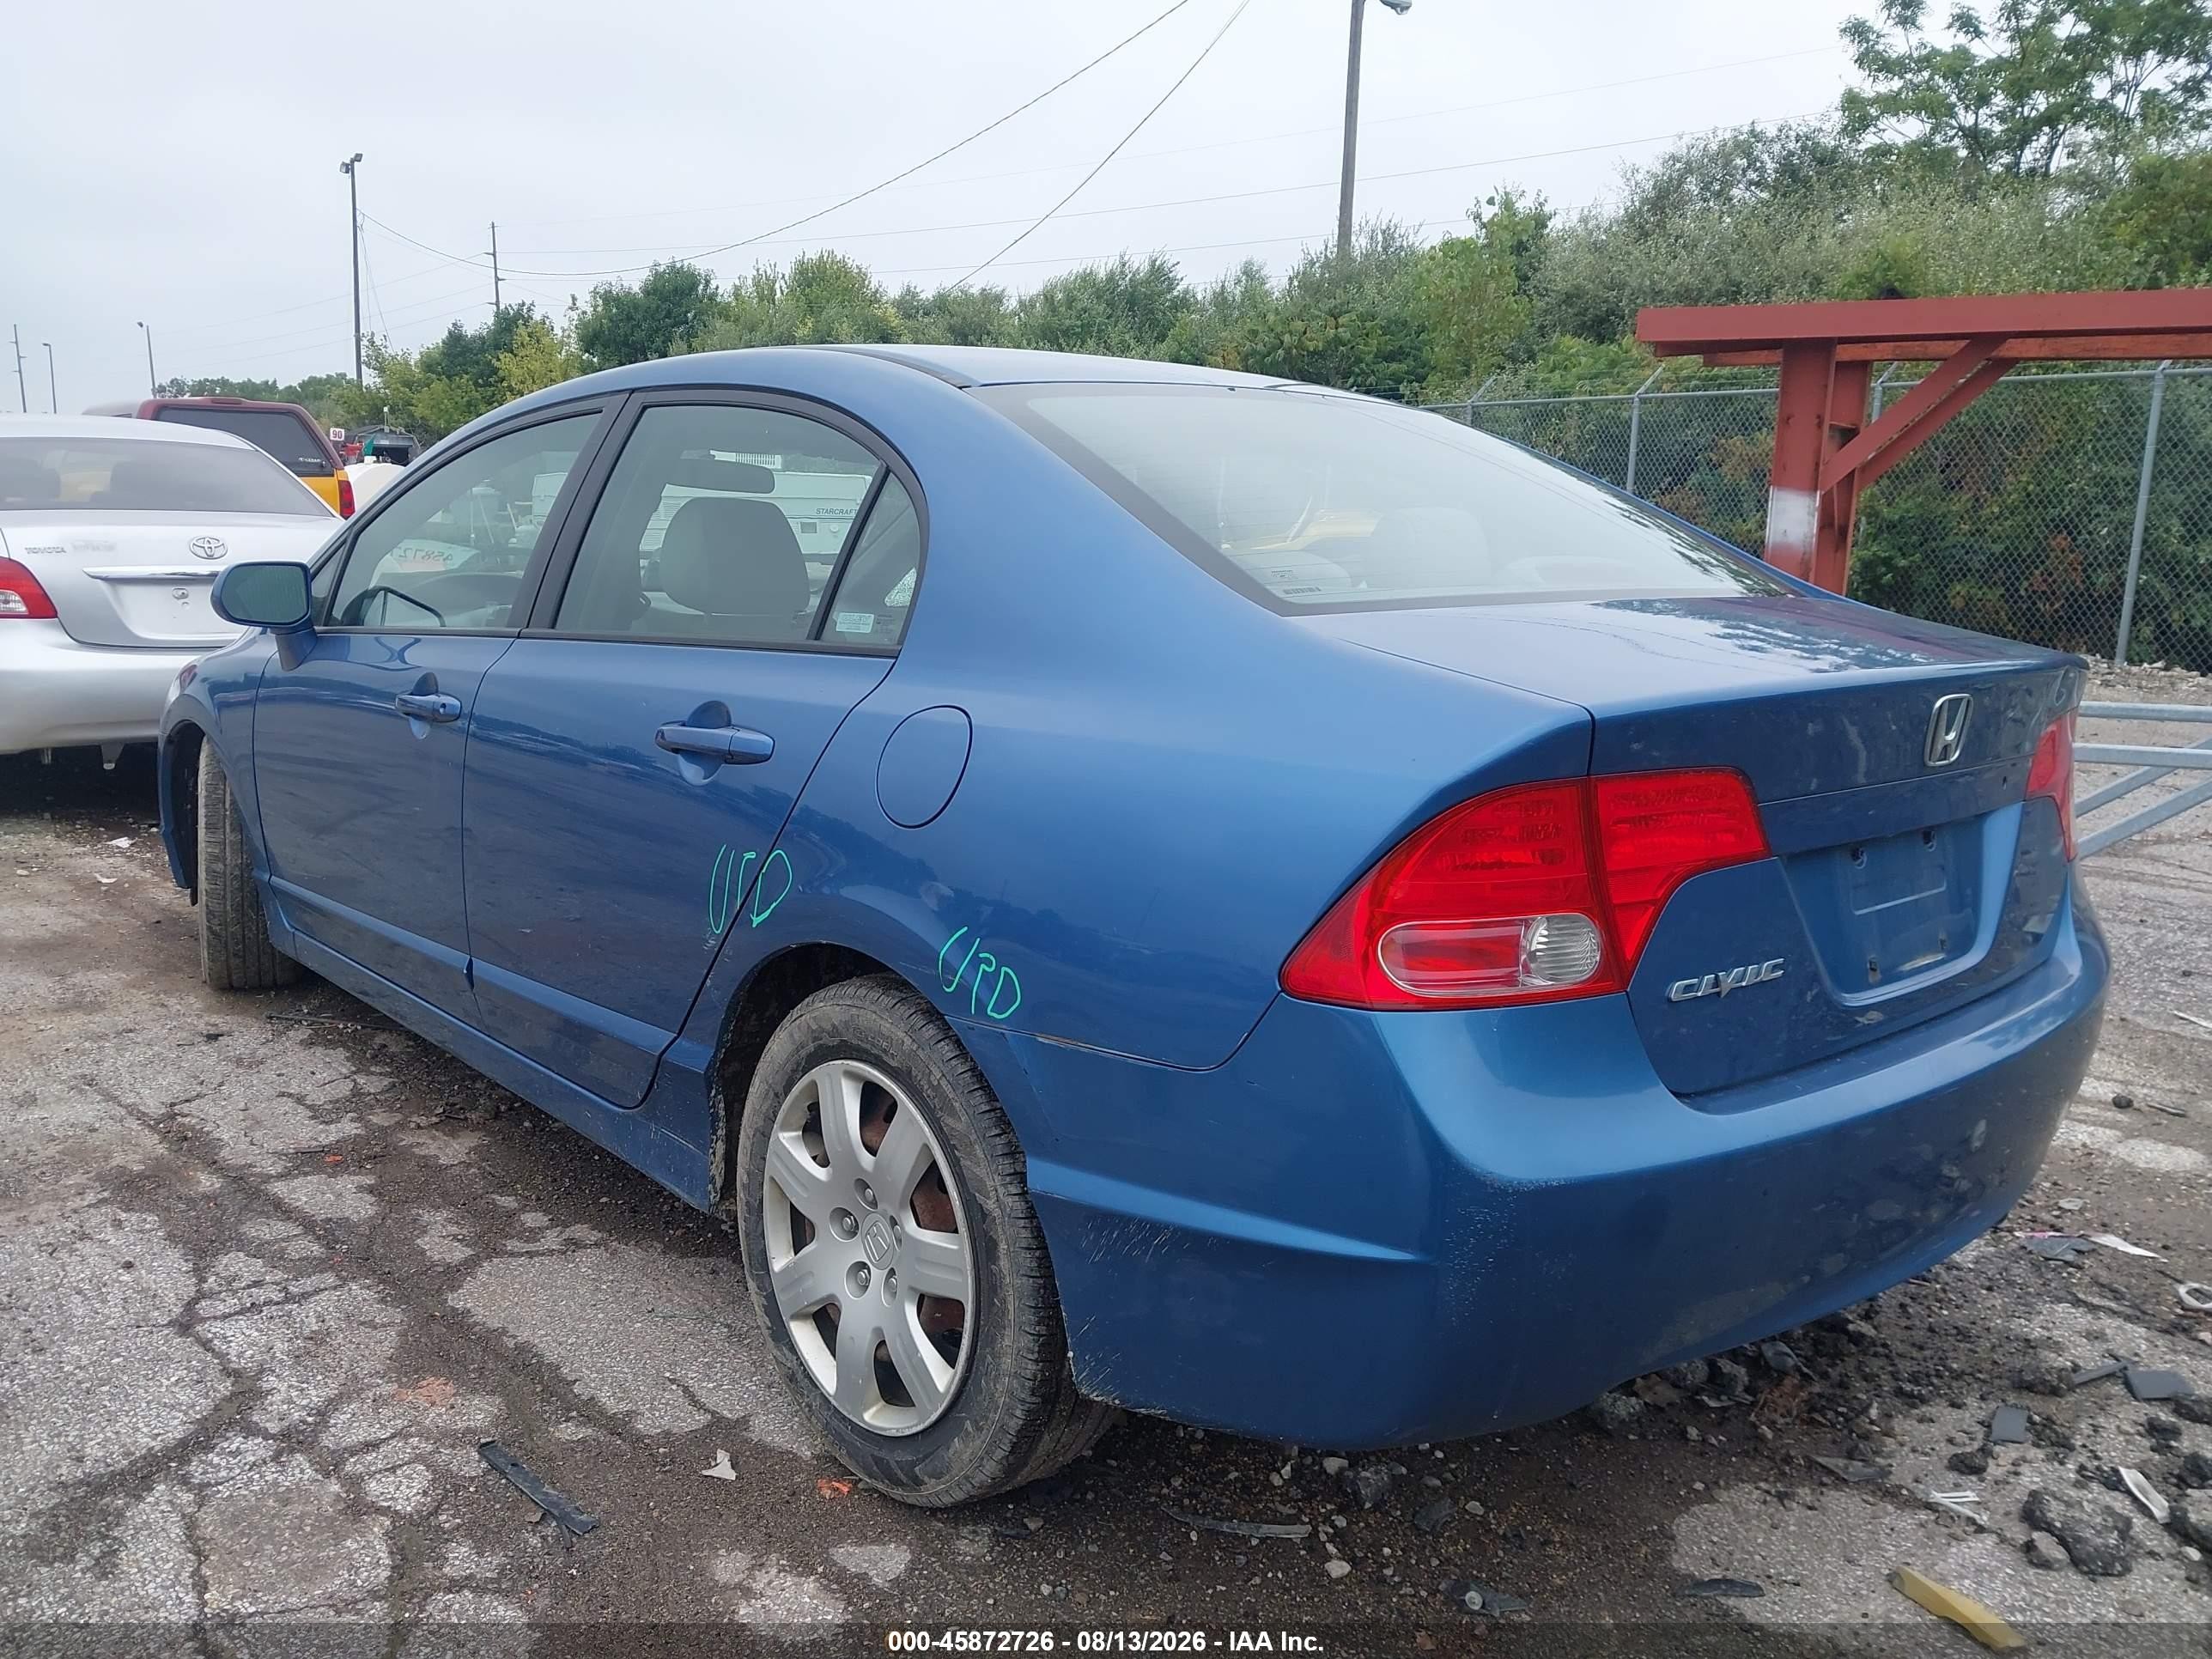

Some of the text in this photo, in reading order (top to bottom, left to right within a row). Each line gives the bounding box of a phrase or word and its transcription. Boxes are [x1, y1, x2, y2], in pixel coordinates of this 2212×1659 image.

[332, 429, 343, 440] 90
[24, 545, 67, 555] TOYOTA
[1668, 957, 1785, 1002] CIVIC
